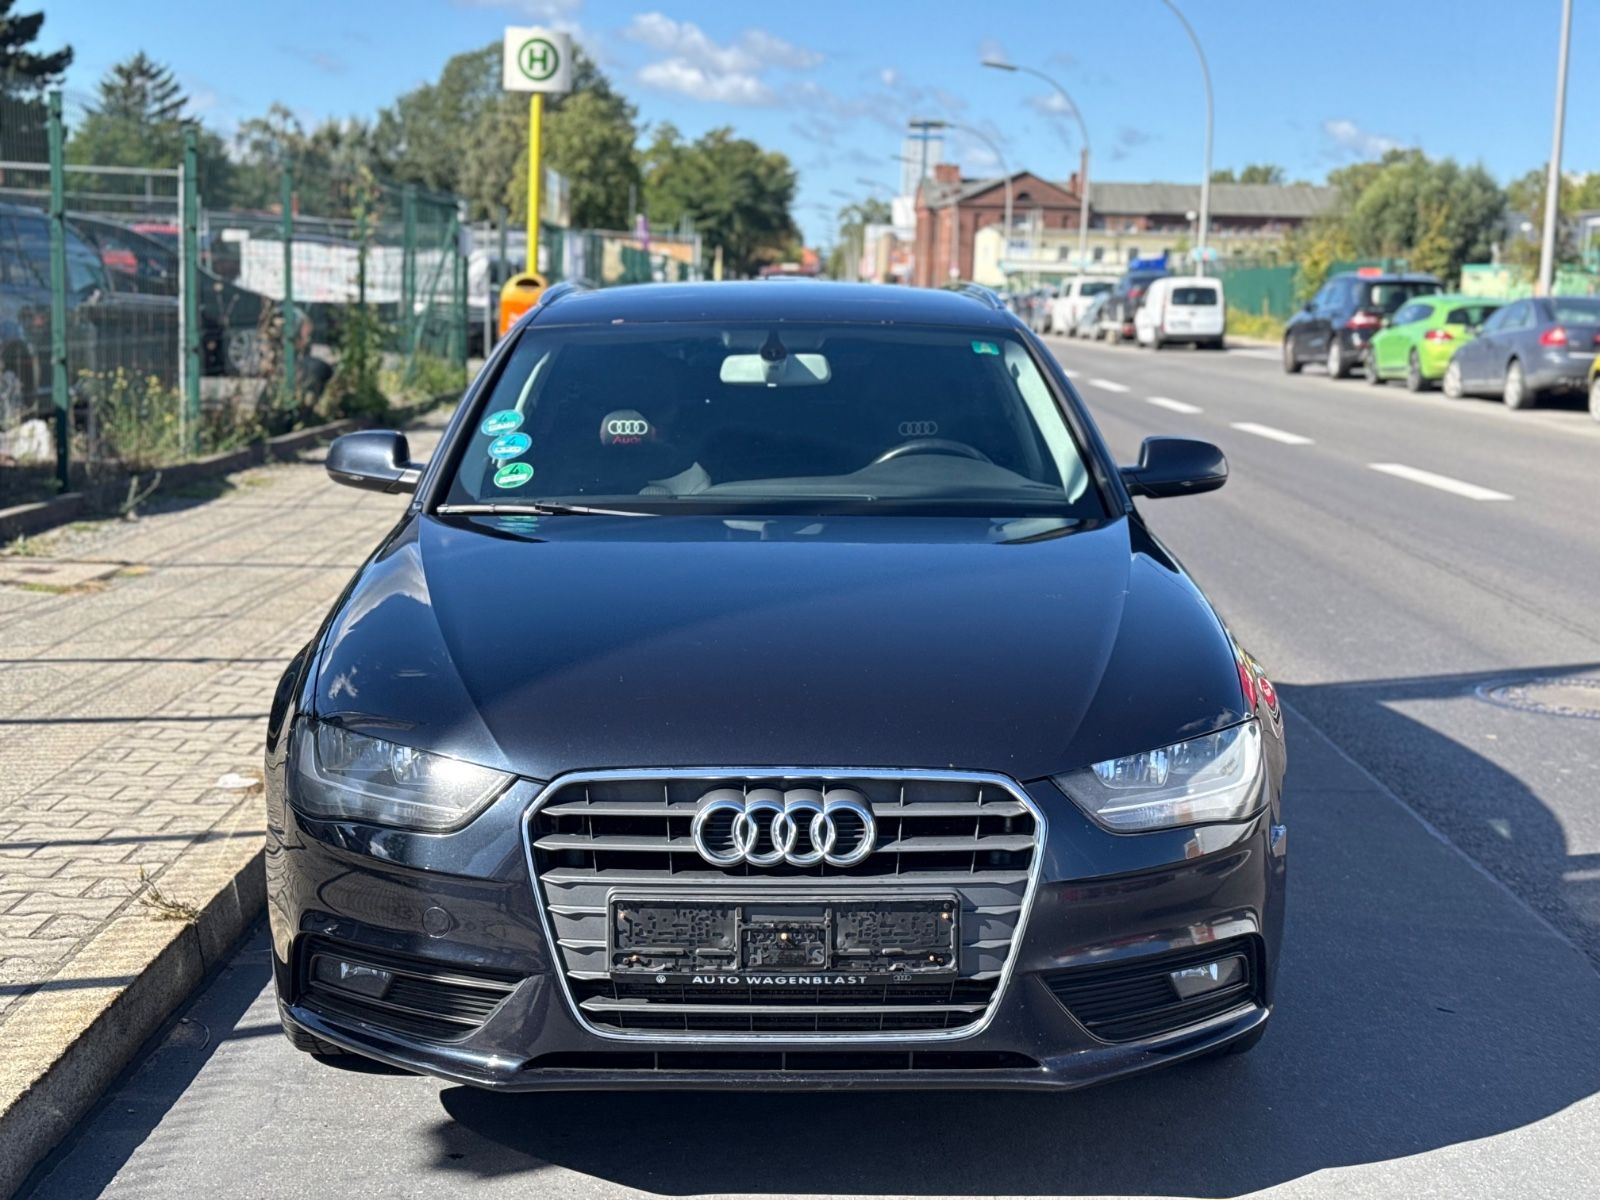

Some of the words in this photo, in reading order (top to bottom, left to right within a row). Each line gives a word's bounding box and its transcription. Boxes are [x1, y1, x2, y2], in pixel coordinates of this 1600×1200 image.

[529, 48, 548, 71] H
[509, 464, 520, 475] 4
[692, 975, 740, 985] AUTO
[746, 975, 868, 985] WAGENBLAST
